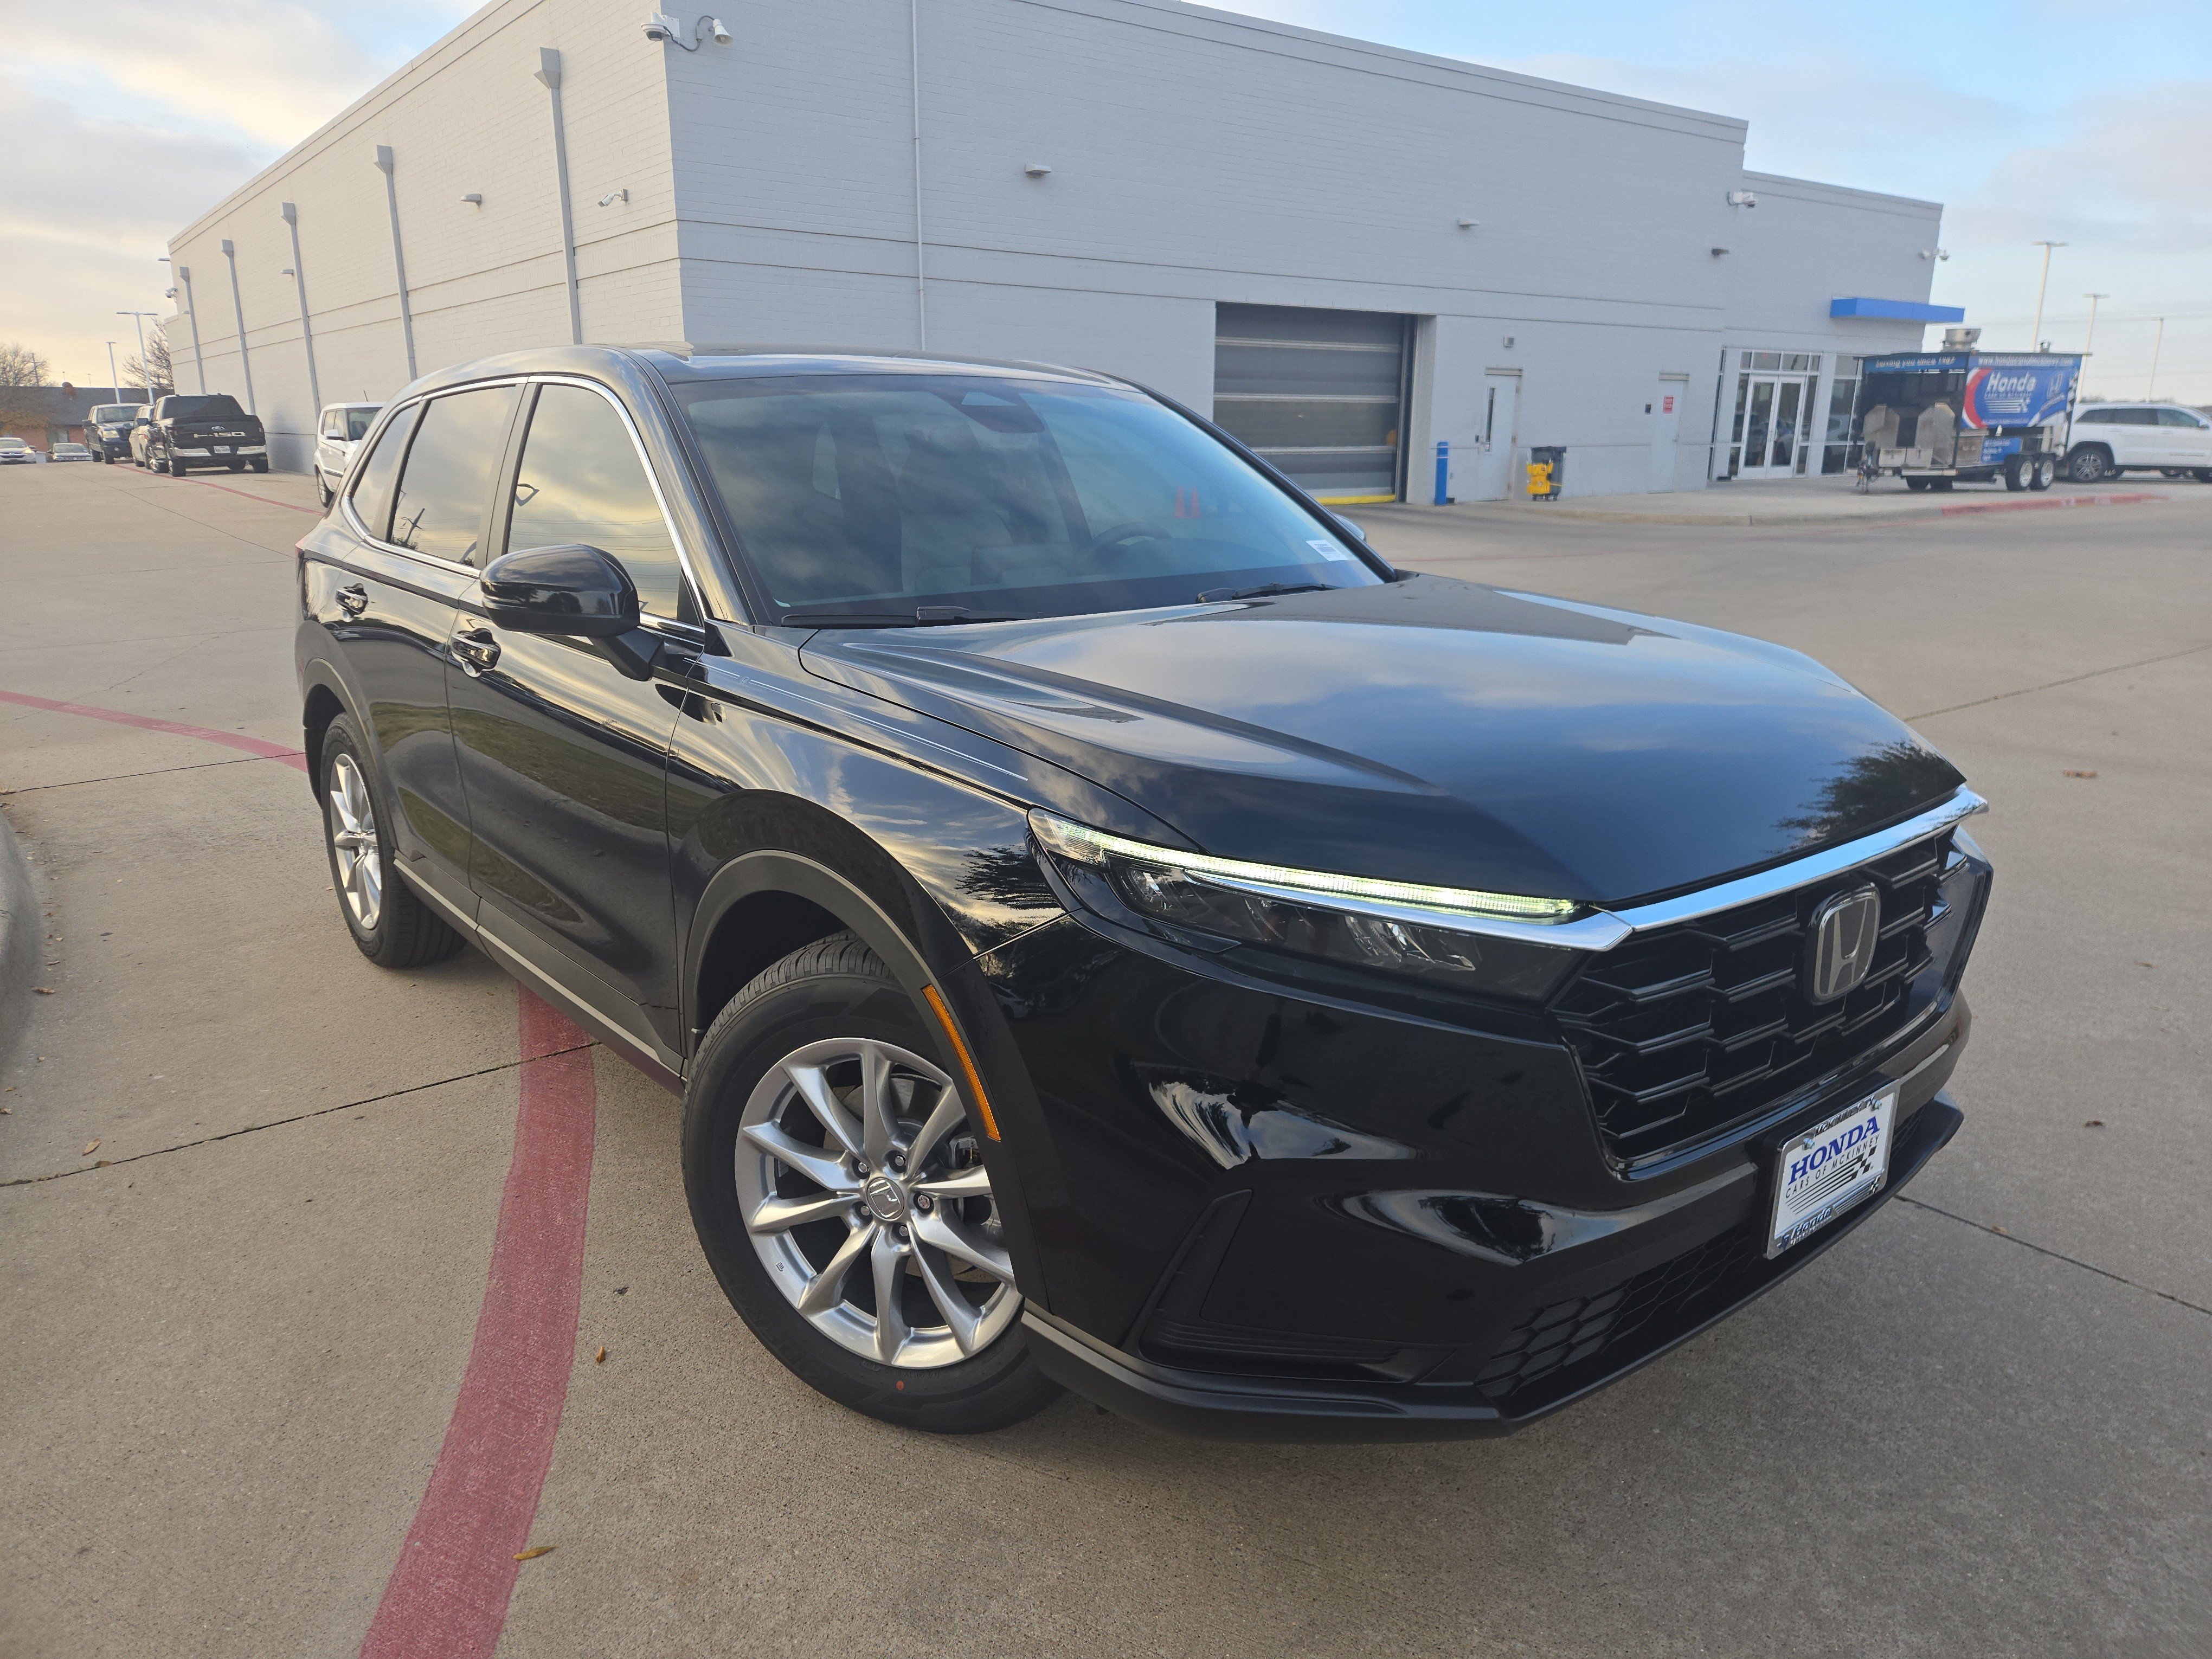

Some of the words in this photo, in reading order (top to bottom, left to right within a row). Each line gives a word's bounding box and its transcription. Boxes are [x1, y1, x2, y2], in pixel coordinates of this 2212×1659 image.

[1986, 371, 2036, 392] Honda
[1785, 1175, 1810, 1198] CARS
[1815, 1164, 1827, 1179] OF
[1831, 1134, 1880, 1171] MCKINNEY
[1788, 1116, 1880, 1186] HONDA
